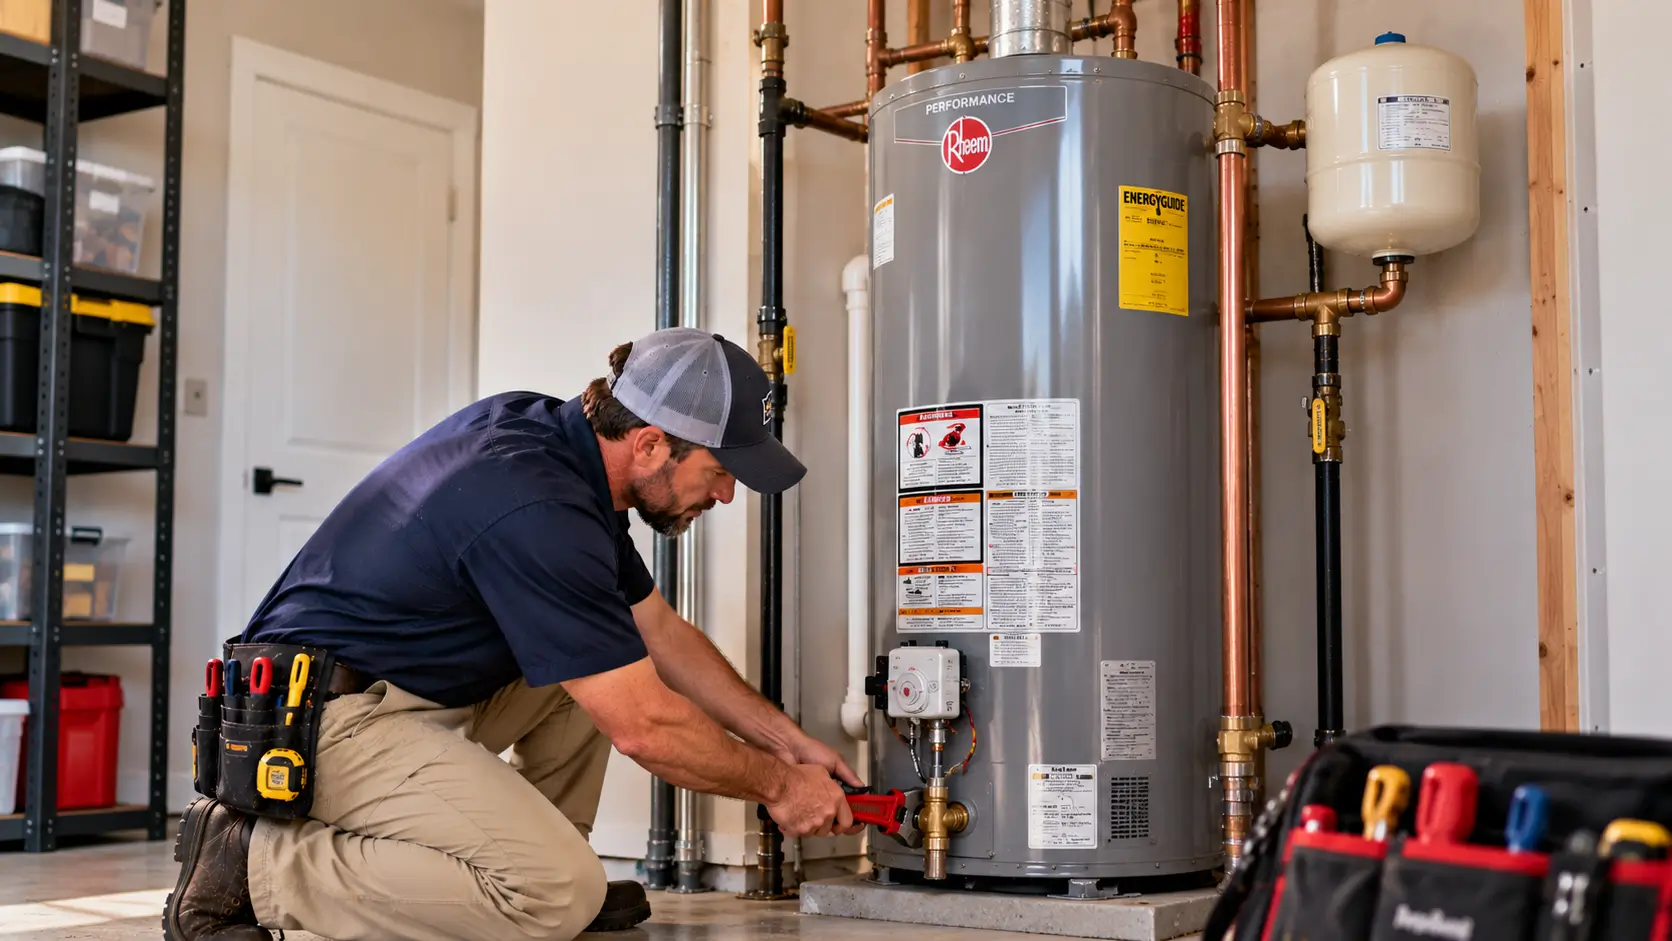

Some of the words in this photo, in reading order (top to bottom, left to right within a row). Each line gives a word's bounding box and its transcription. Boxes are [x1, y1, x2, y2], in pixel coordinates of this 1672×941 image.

[925, 92, 1015, 115] PERFORMANCE
[947, 118, 989, 166] Rheem
[1123, 190, 1185, 213] ENERGYGUIDE
